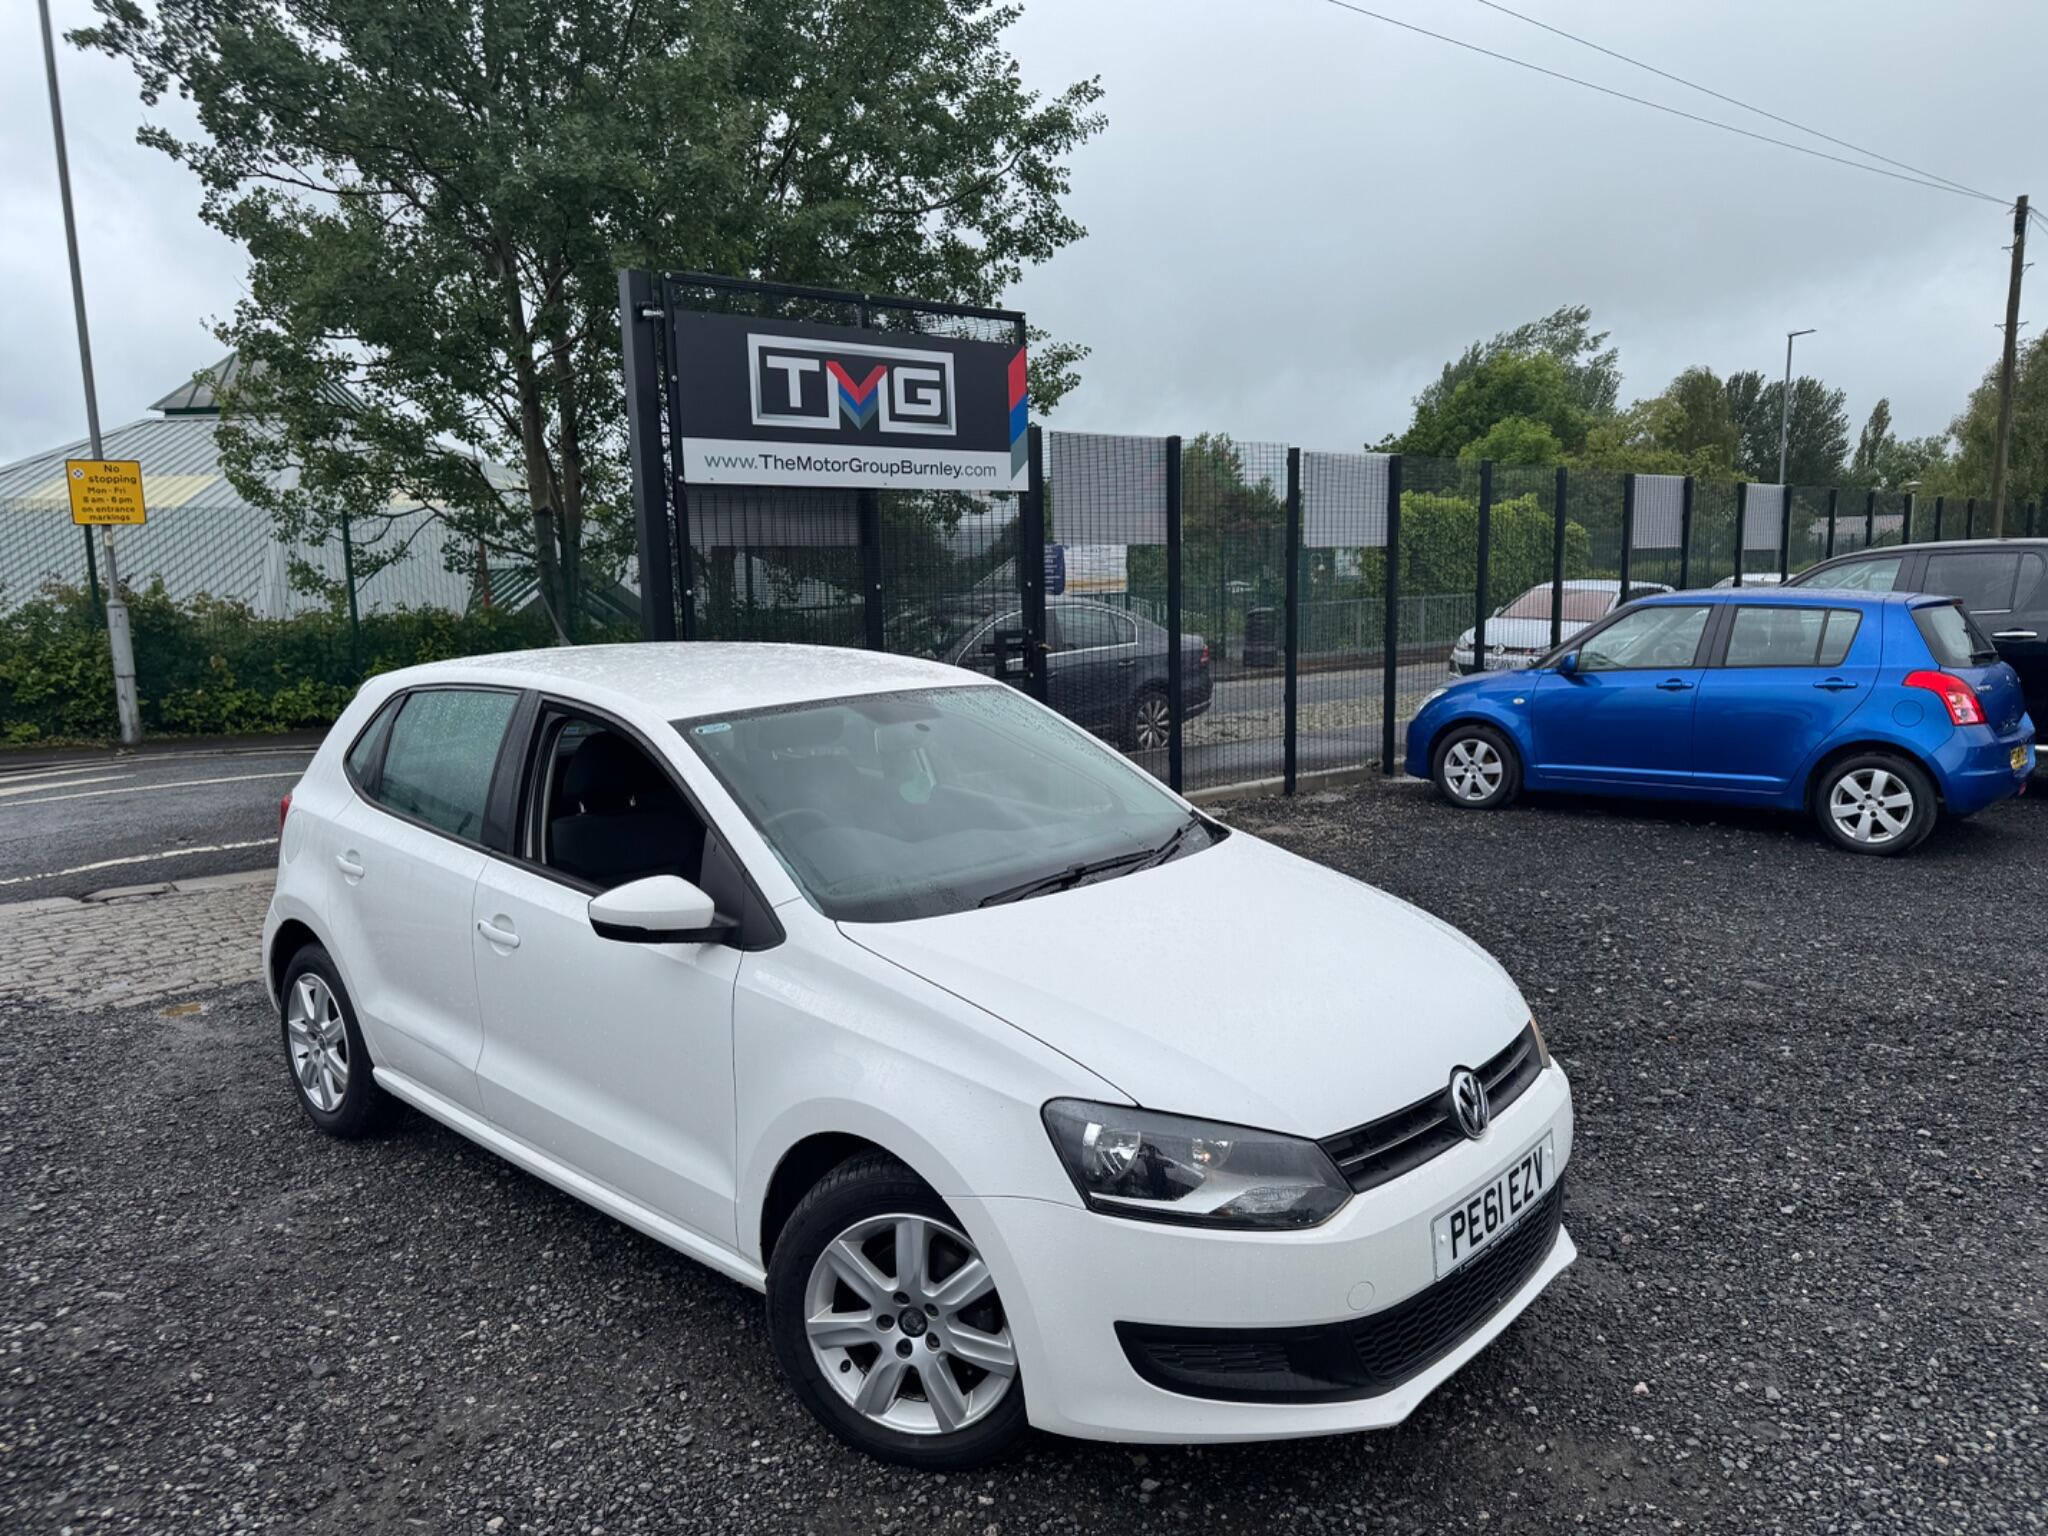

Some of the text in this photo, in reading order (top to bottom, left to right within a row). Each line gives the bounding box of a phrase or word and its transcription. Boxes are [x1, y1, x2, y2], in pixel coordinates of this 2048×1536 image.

[766, 355, 942, 431] TMG
[104, 464, 120, 473] No
[704, 454, 997, 477] www.TheMotorGroupBurnley.com
[88, 475, 137, 484] stopping
[1450, 1146, 1543, 1260] PE61 EZV
